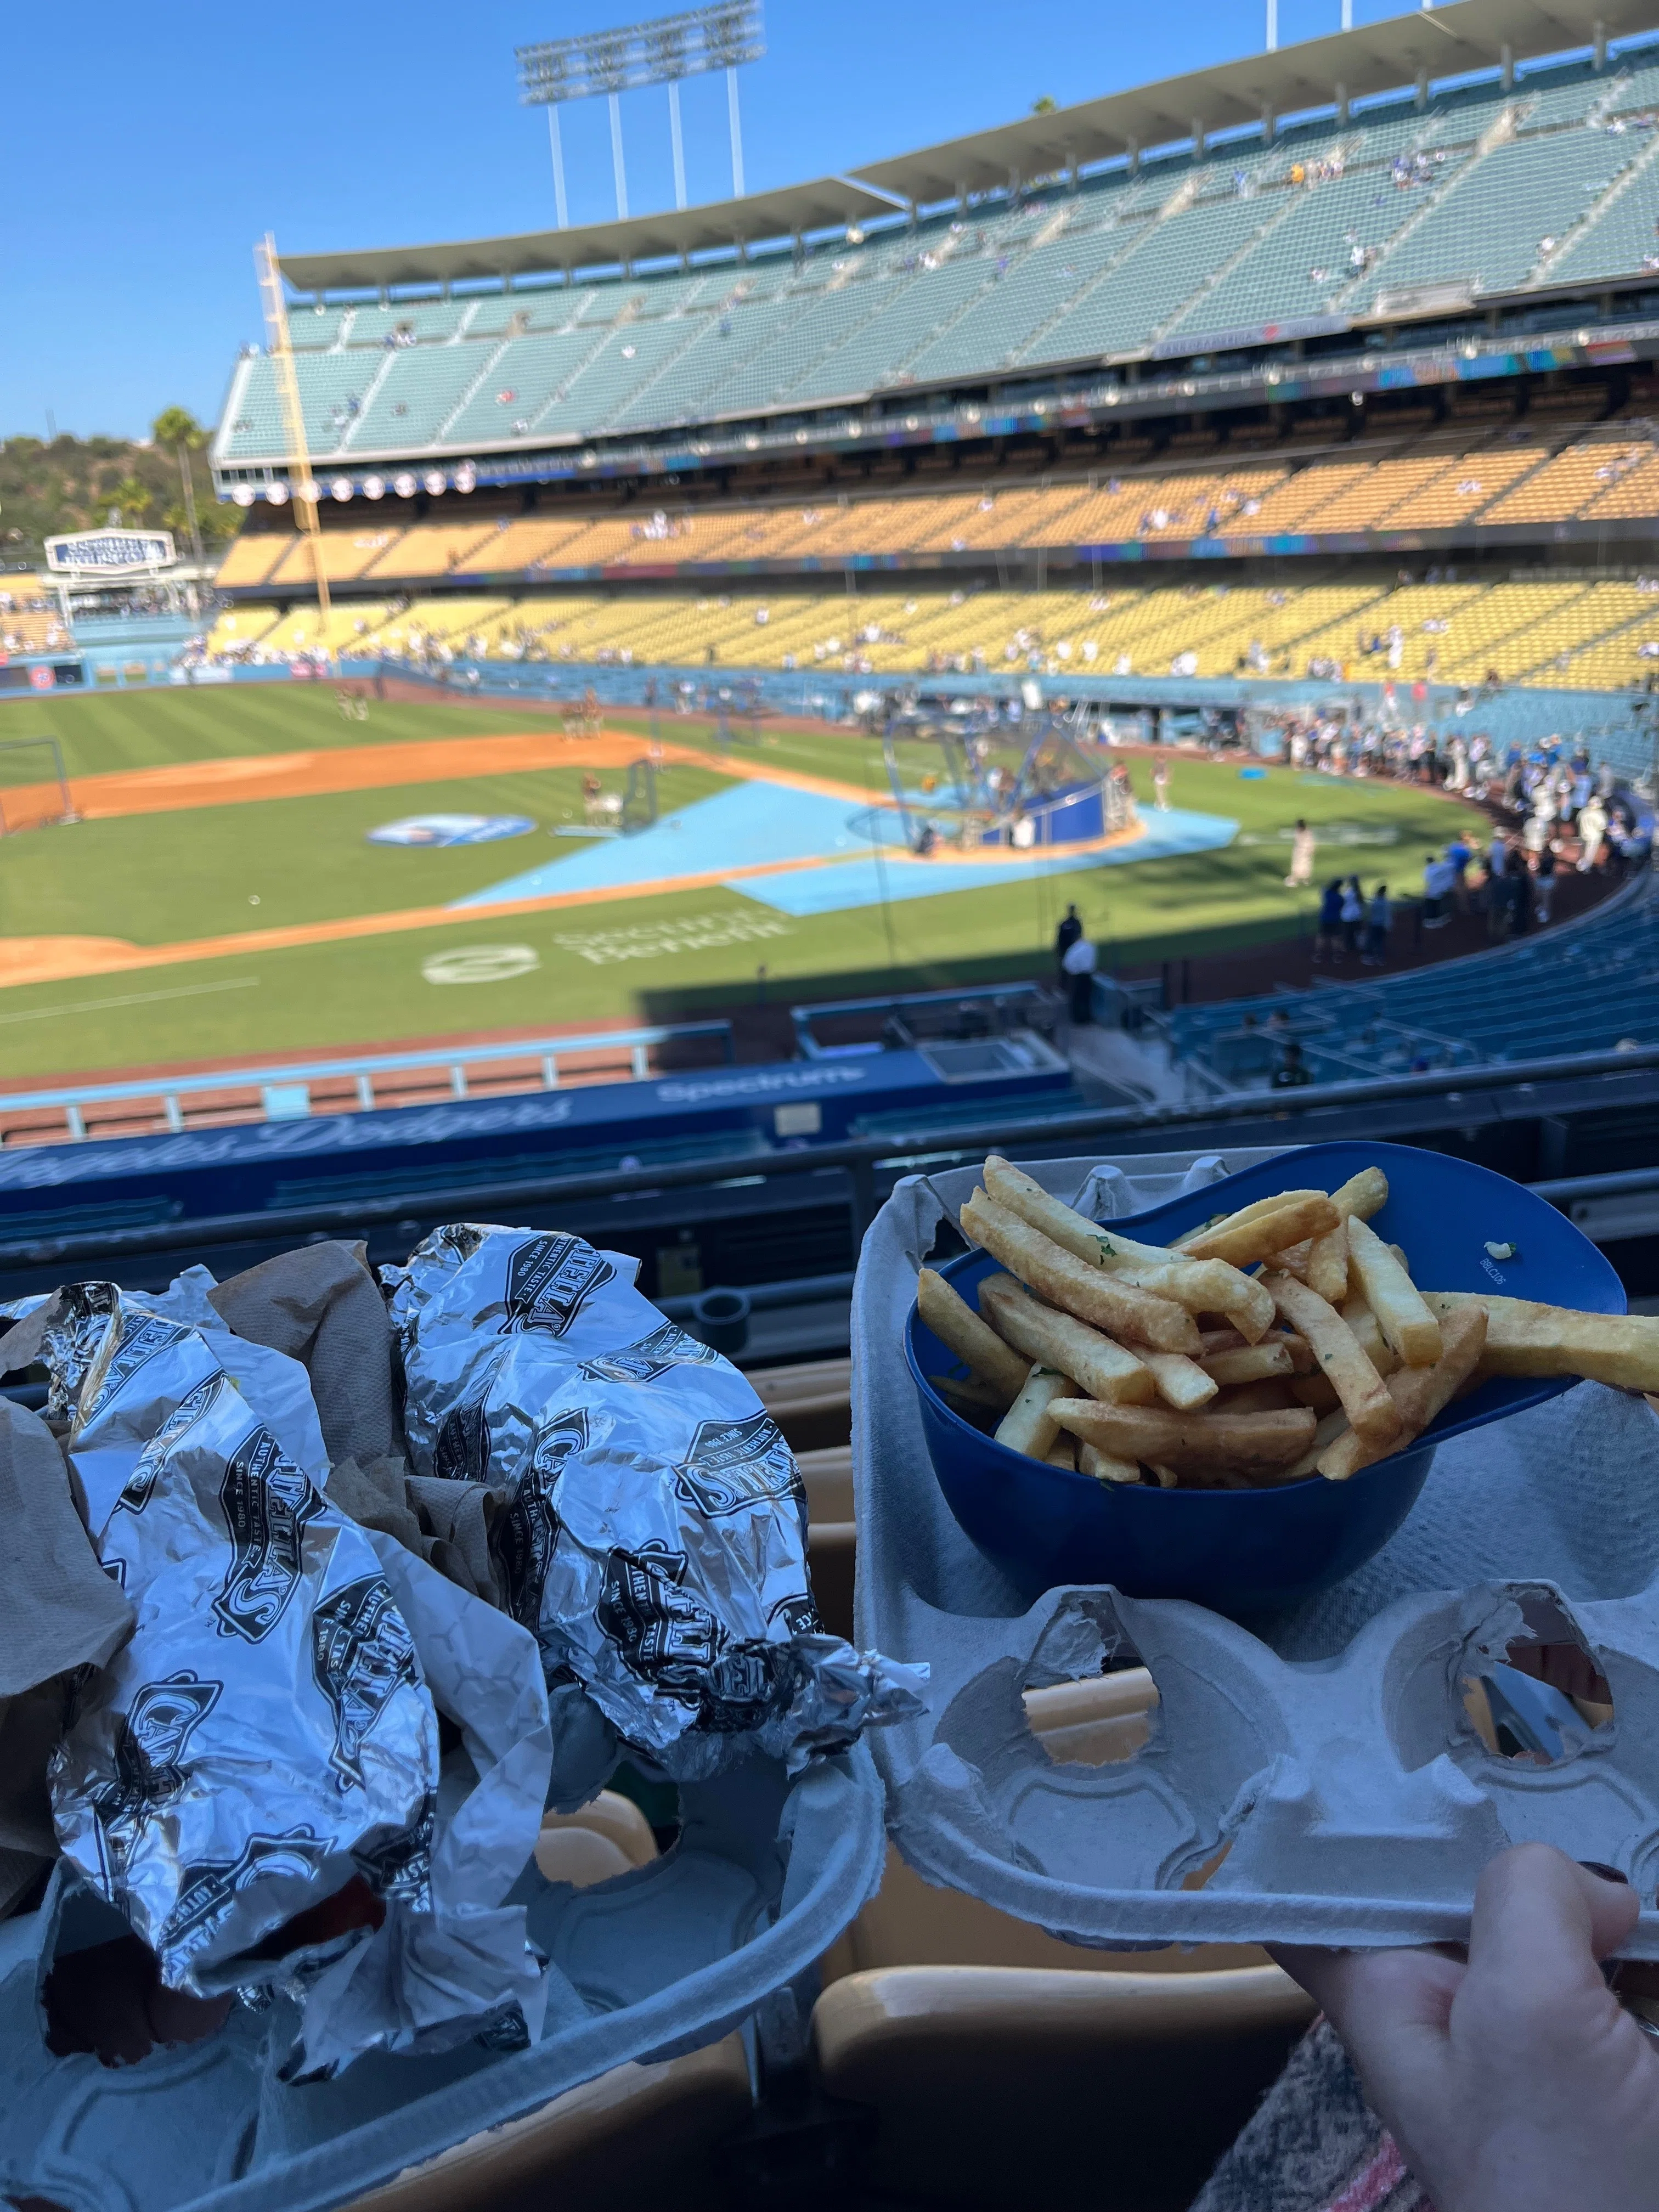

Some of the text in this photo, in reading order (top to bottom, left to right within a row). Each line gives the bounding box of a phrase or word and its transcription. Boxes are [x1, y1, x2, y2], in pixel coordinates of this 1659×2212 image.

[517, 1240, 548, 1276] SINCE 1980
[525, 1236, 569, 1293] UTHENTIC TASTE
[704, 1428, 743, 1448] SINCE 1980
[733, 1429, 772, 1455] AUTHENTIC
[235, 1461, 246, 1528] SINCE 1980
[251, 1441, 272, 1552] AUTHENTIC TASTE
[611, 1580, 627, 1615] SINCE
[317, 1628, 329, 1662] 1980
[643, 1622, 657, 1662] TASTE
